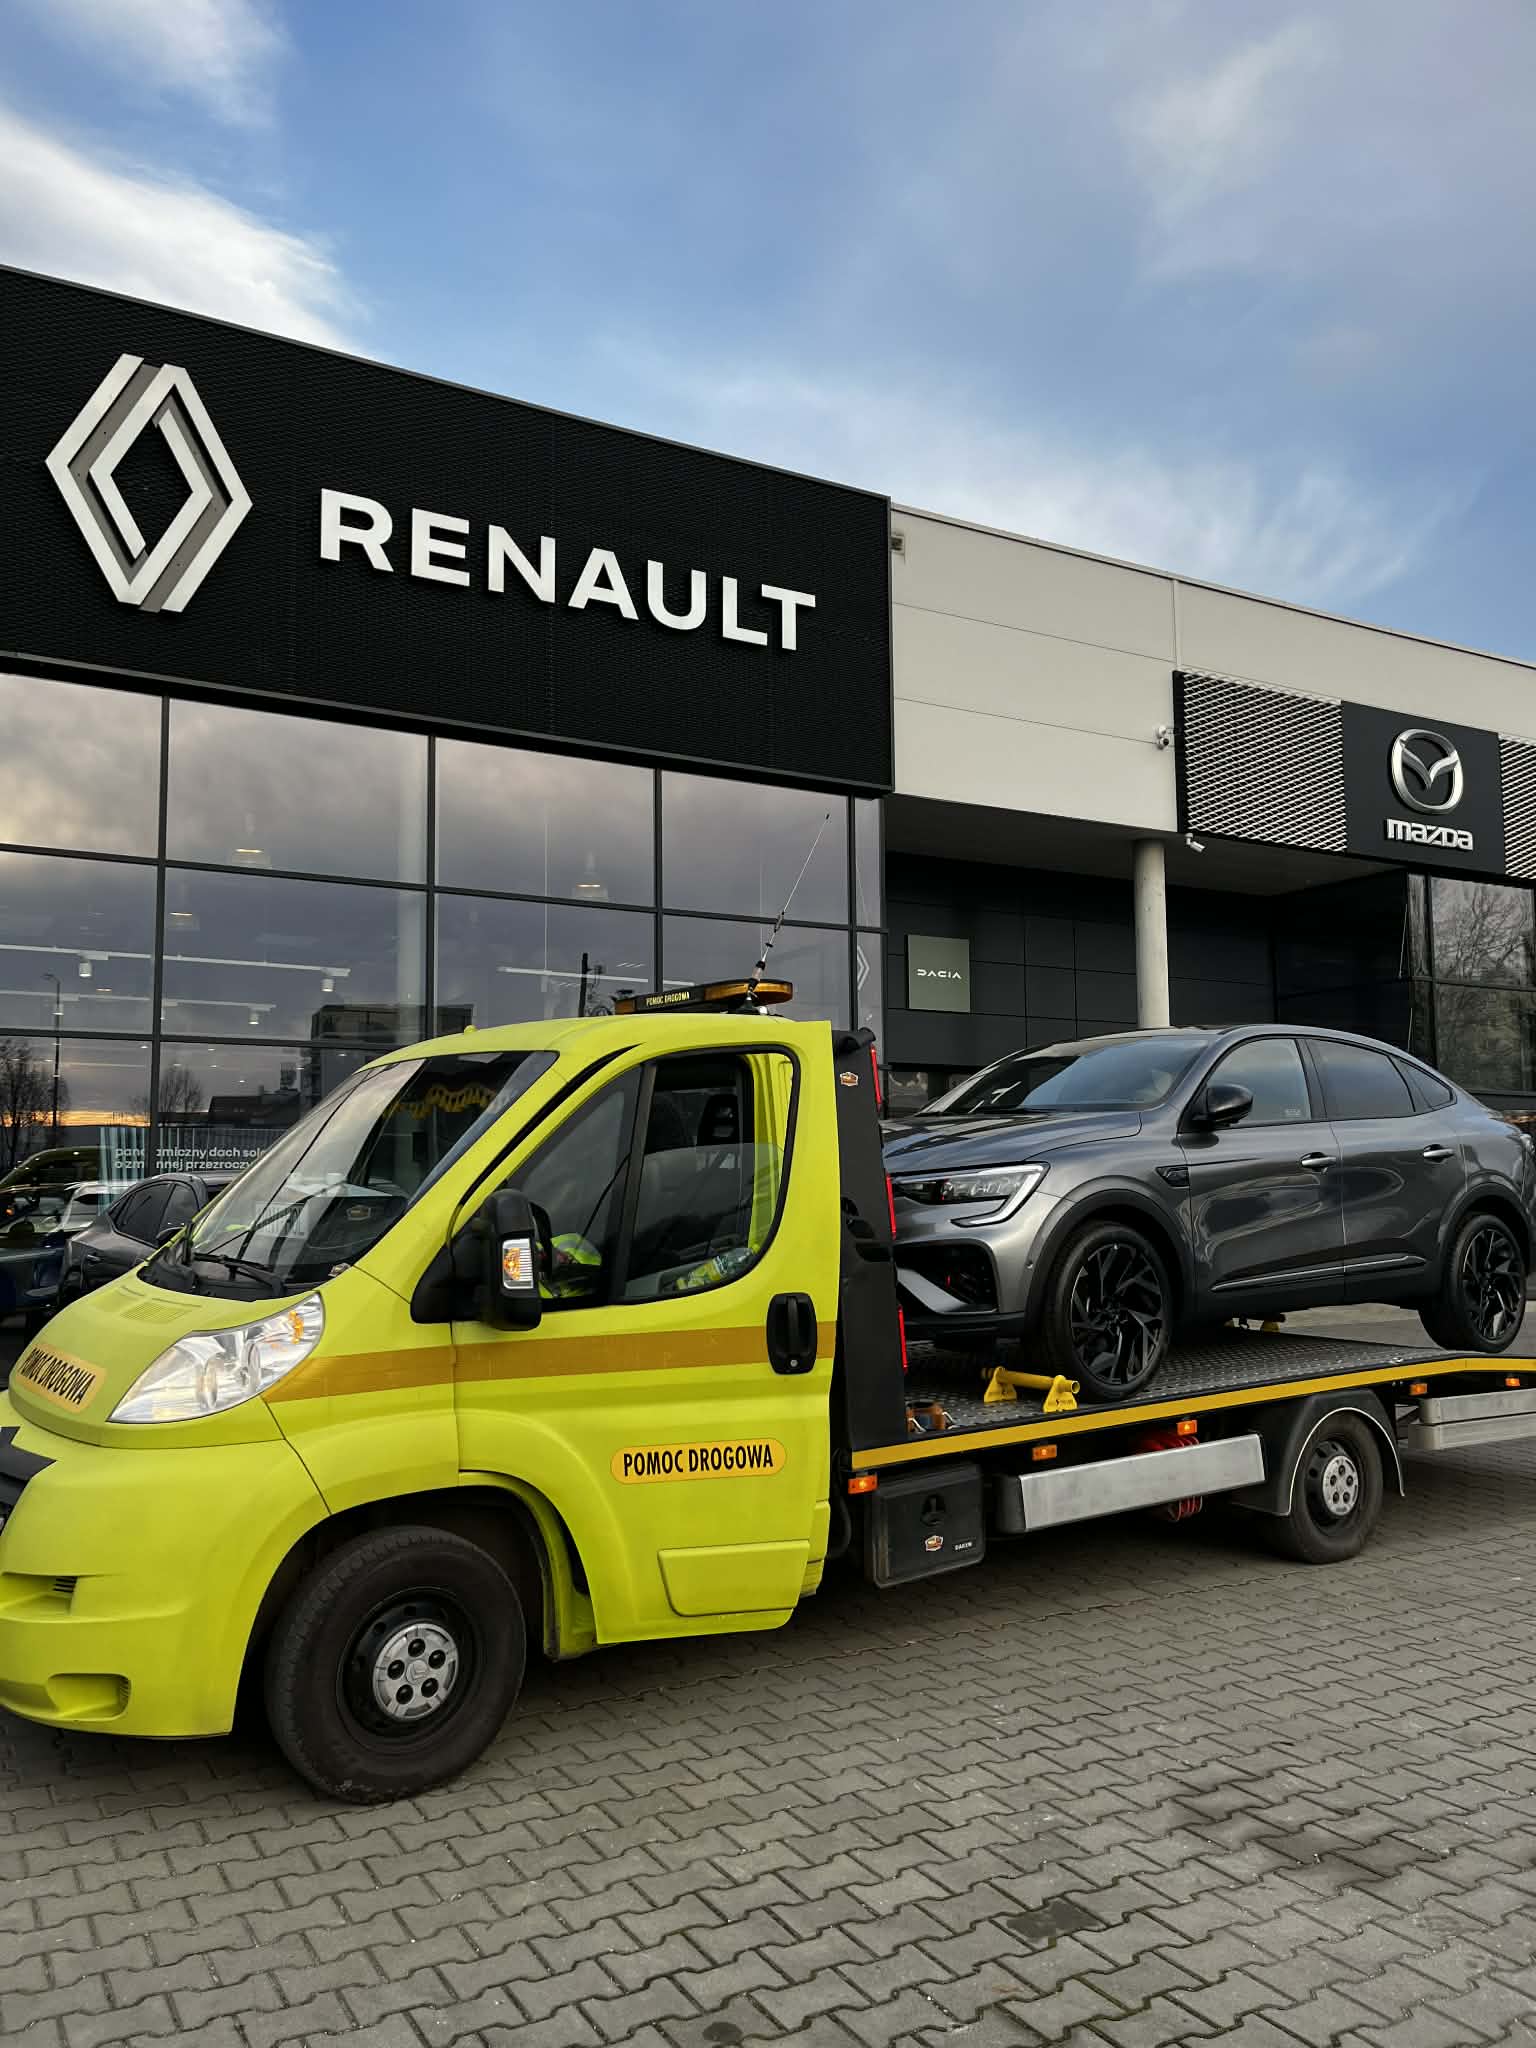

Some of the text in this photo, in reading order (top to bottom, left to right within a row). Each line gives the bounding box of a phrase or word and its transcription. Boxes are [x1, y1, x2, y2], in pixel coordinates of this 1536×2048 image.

[320, 487, 816, 651] RENAULT
[1386, 818, 1474, 851] mazda
[917, 968, 962, 980] DACIA
[125, 1159, 183, 1171] zmnnej
[209, 1147, 240, 1157] dach
[39, 1356, 96, 1405] DROGOWA
[623, 1444, 774, 1477] POMOC DROGOWA
